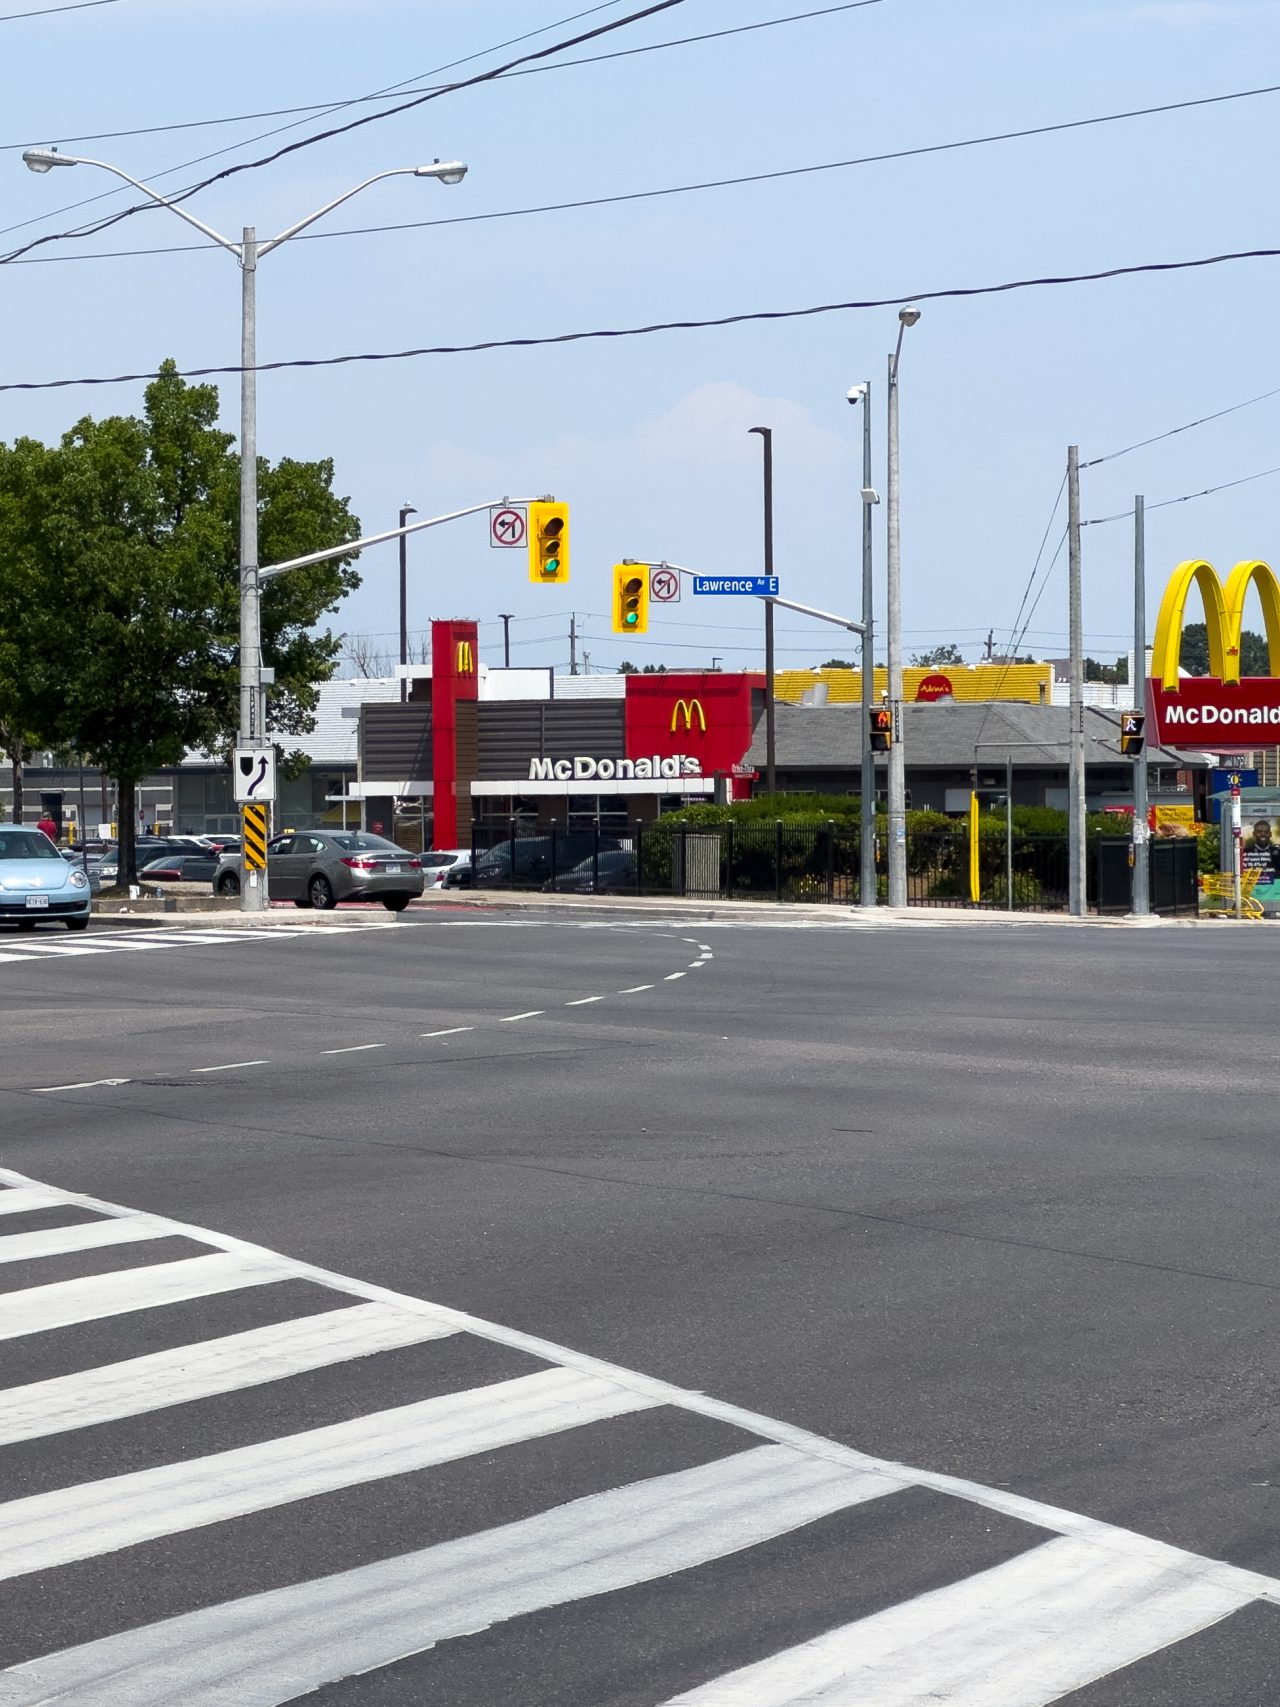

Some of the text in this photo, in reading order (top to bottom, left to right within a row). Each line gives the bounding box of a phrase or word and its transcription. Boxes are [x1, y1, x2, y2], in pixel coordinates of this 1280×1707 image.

[696, 577, 777, 592] Lawrence Av E
[920, 684, 950, 693] Adrian's
[528, 754, 701, 780] McDonald's
